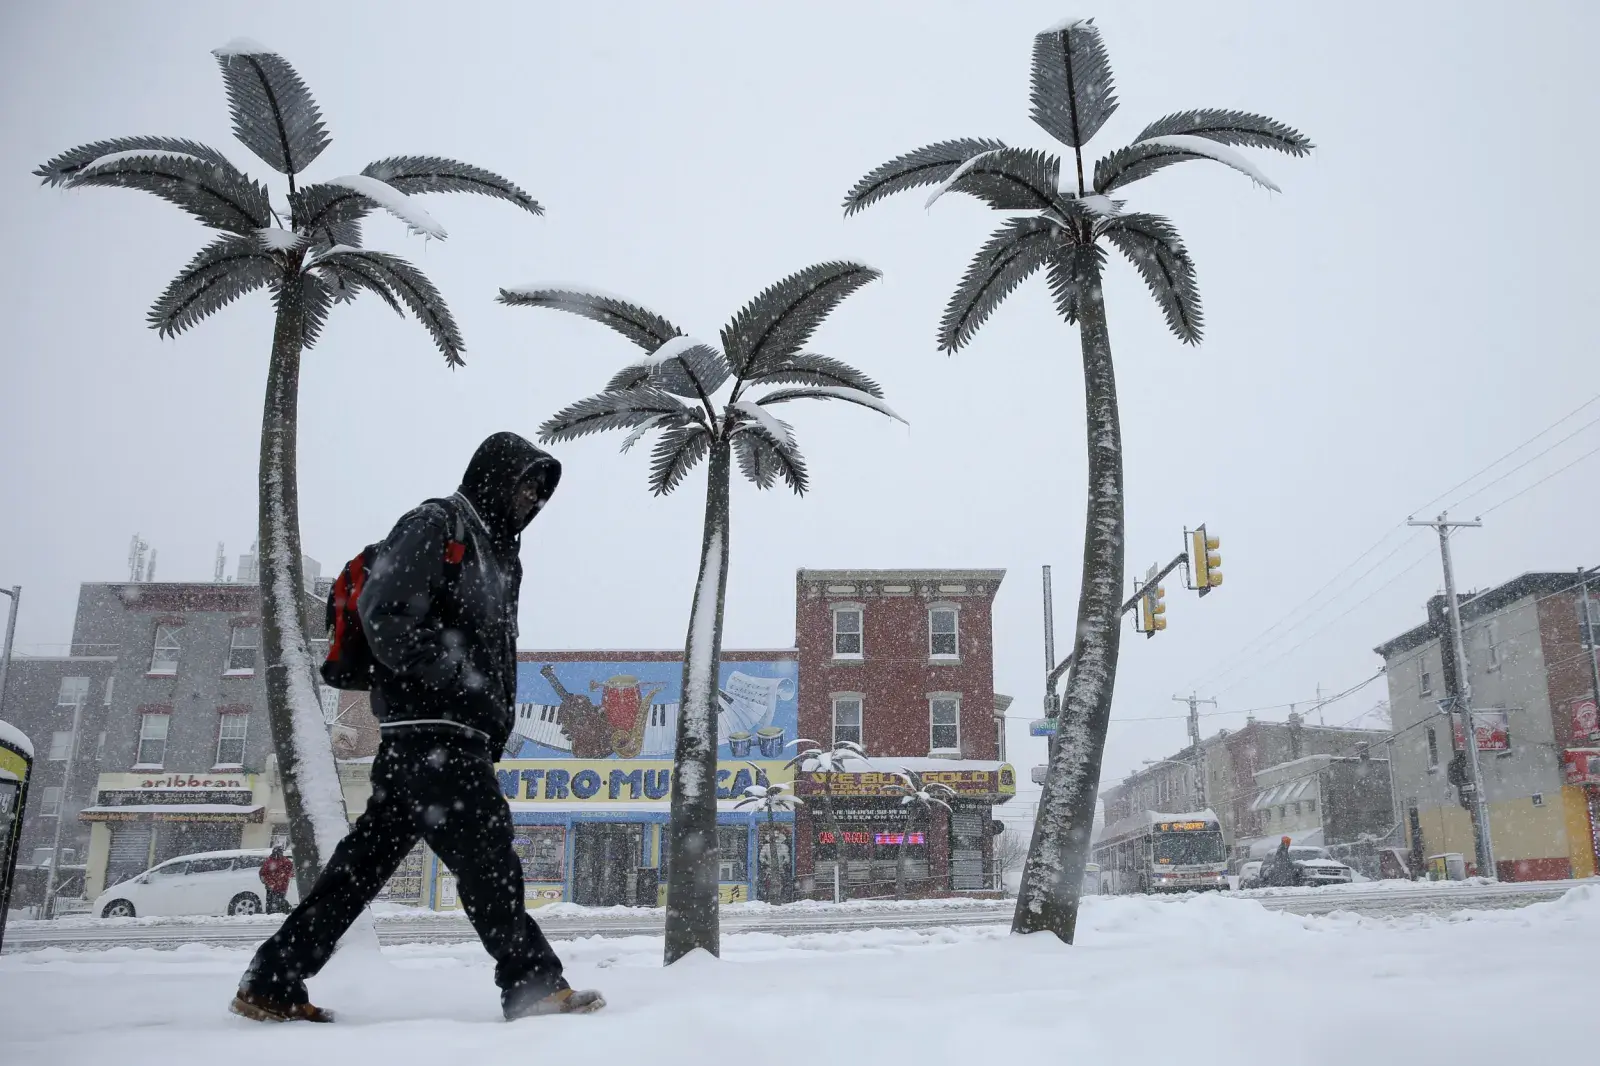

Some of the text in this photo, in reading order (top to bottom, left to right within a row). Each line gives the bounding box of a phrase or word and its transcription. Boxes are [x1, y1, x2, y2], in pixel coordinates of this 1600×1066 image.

[497, 768, 771, 799] NTRO MUCAL
[922, 771, 989, 783] GOLD
